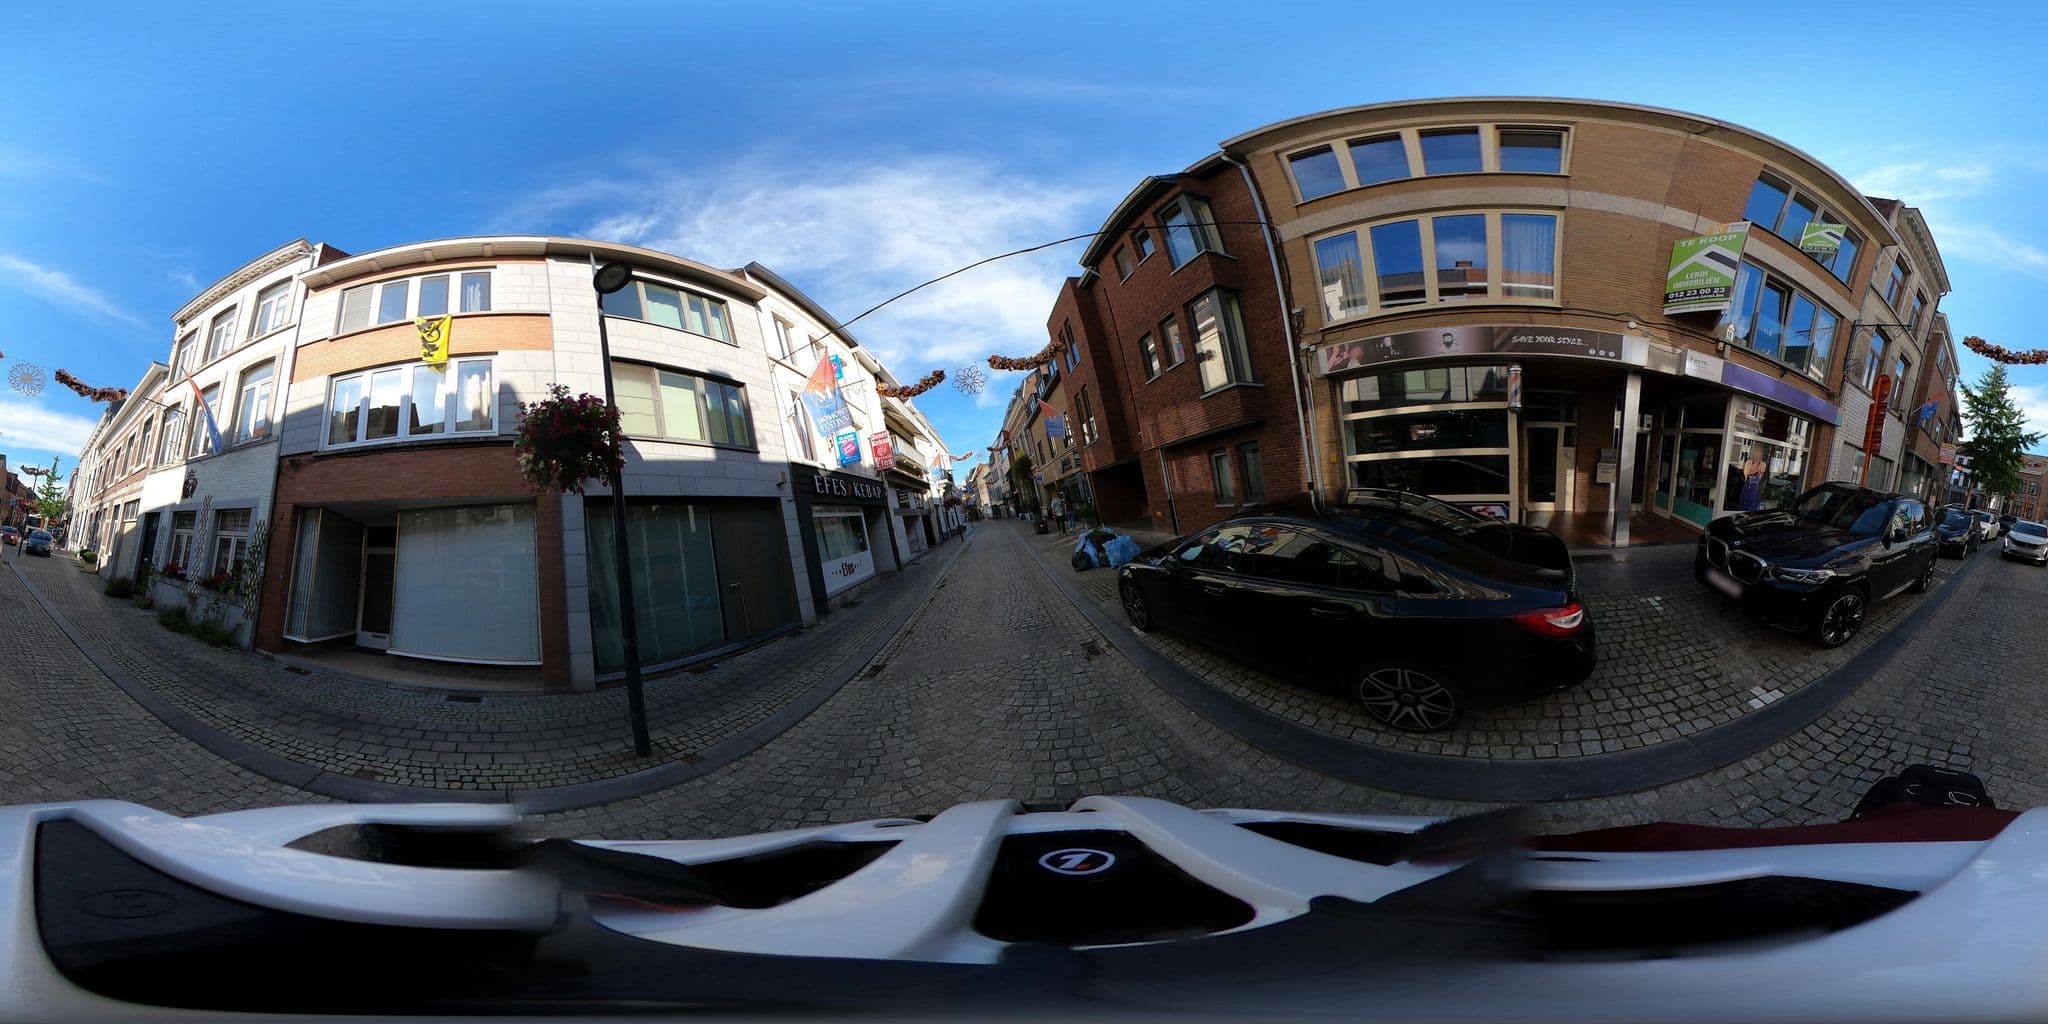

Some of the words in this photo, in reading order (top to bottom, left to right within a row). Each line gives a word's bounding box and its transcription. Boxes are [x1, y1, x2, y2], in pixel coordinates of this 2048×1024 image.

[1681, 240, 1695, 248] TE
[1699, 234, 1737, 244] KOOP
[1668, 291, 1685, 299] 012
[1686, 289, 1698, 297] 23
[1511, 335, 1535, 343] SAVE
[1535, 335, 1556, 344] YOUR
[1690, 357, 1708, 366] Ferm
[814, 475, 847, 496] EFES
